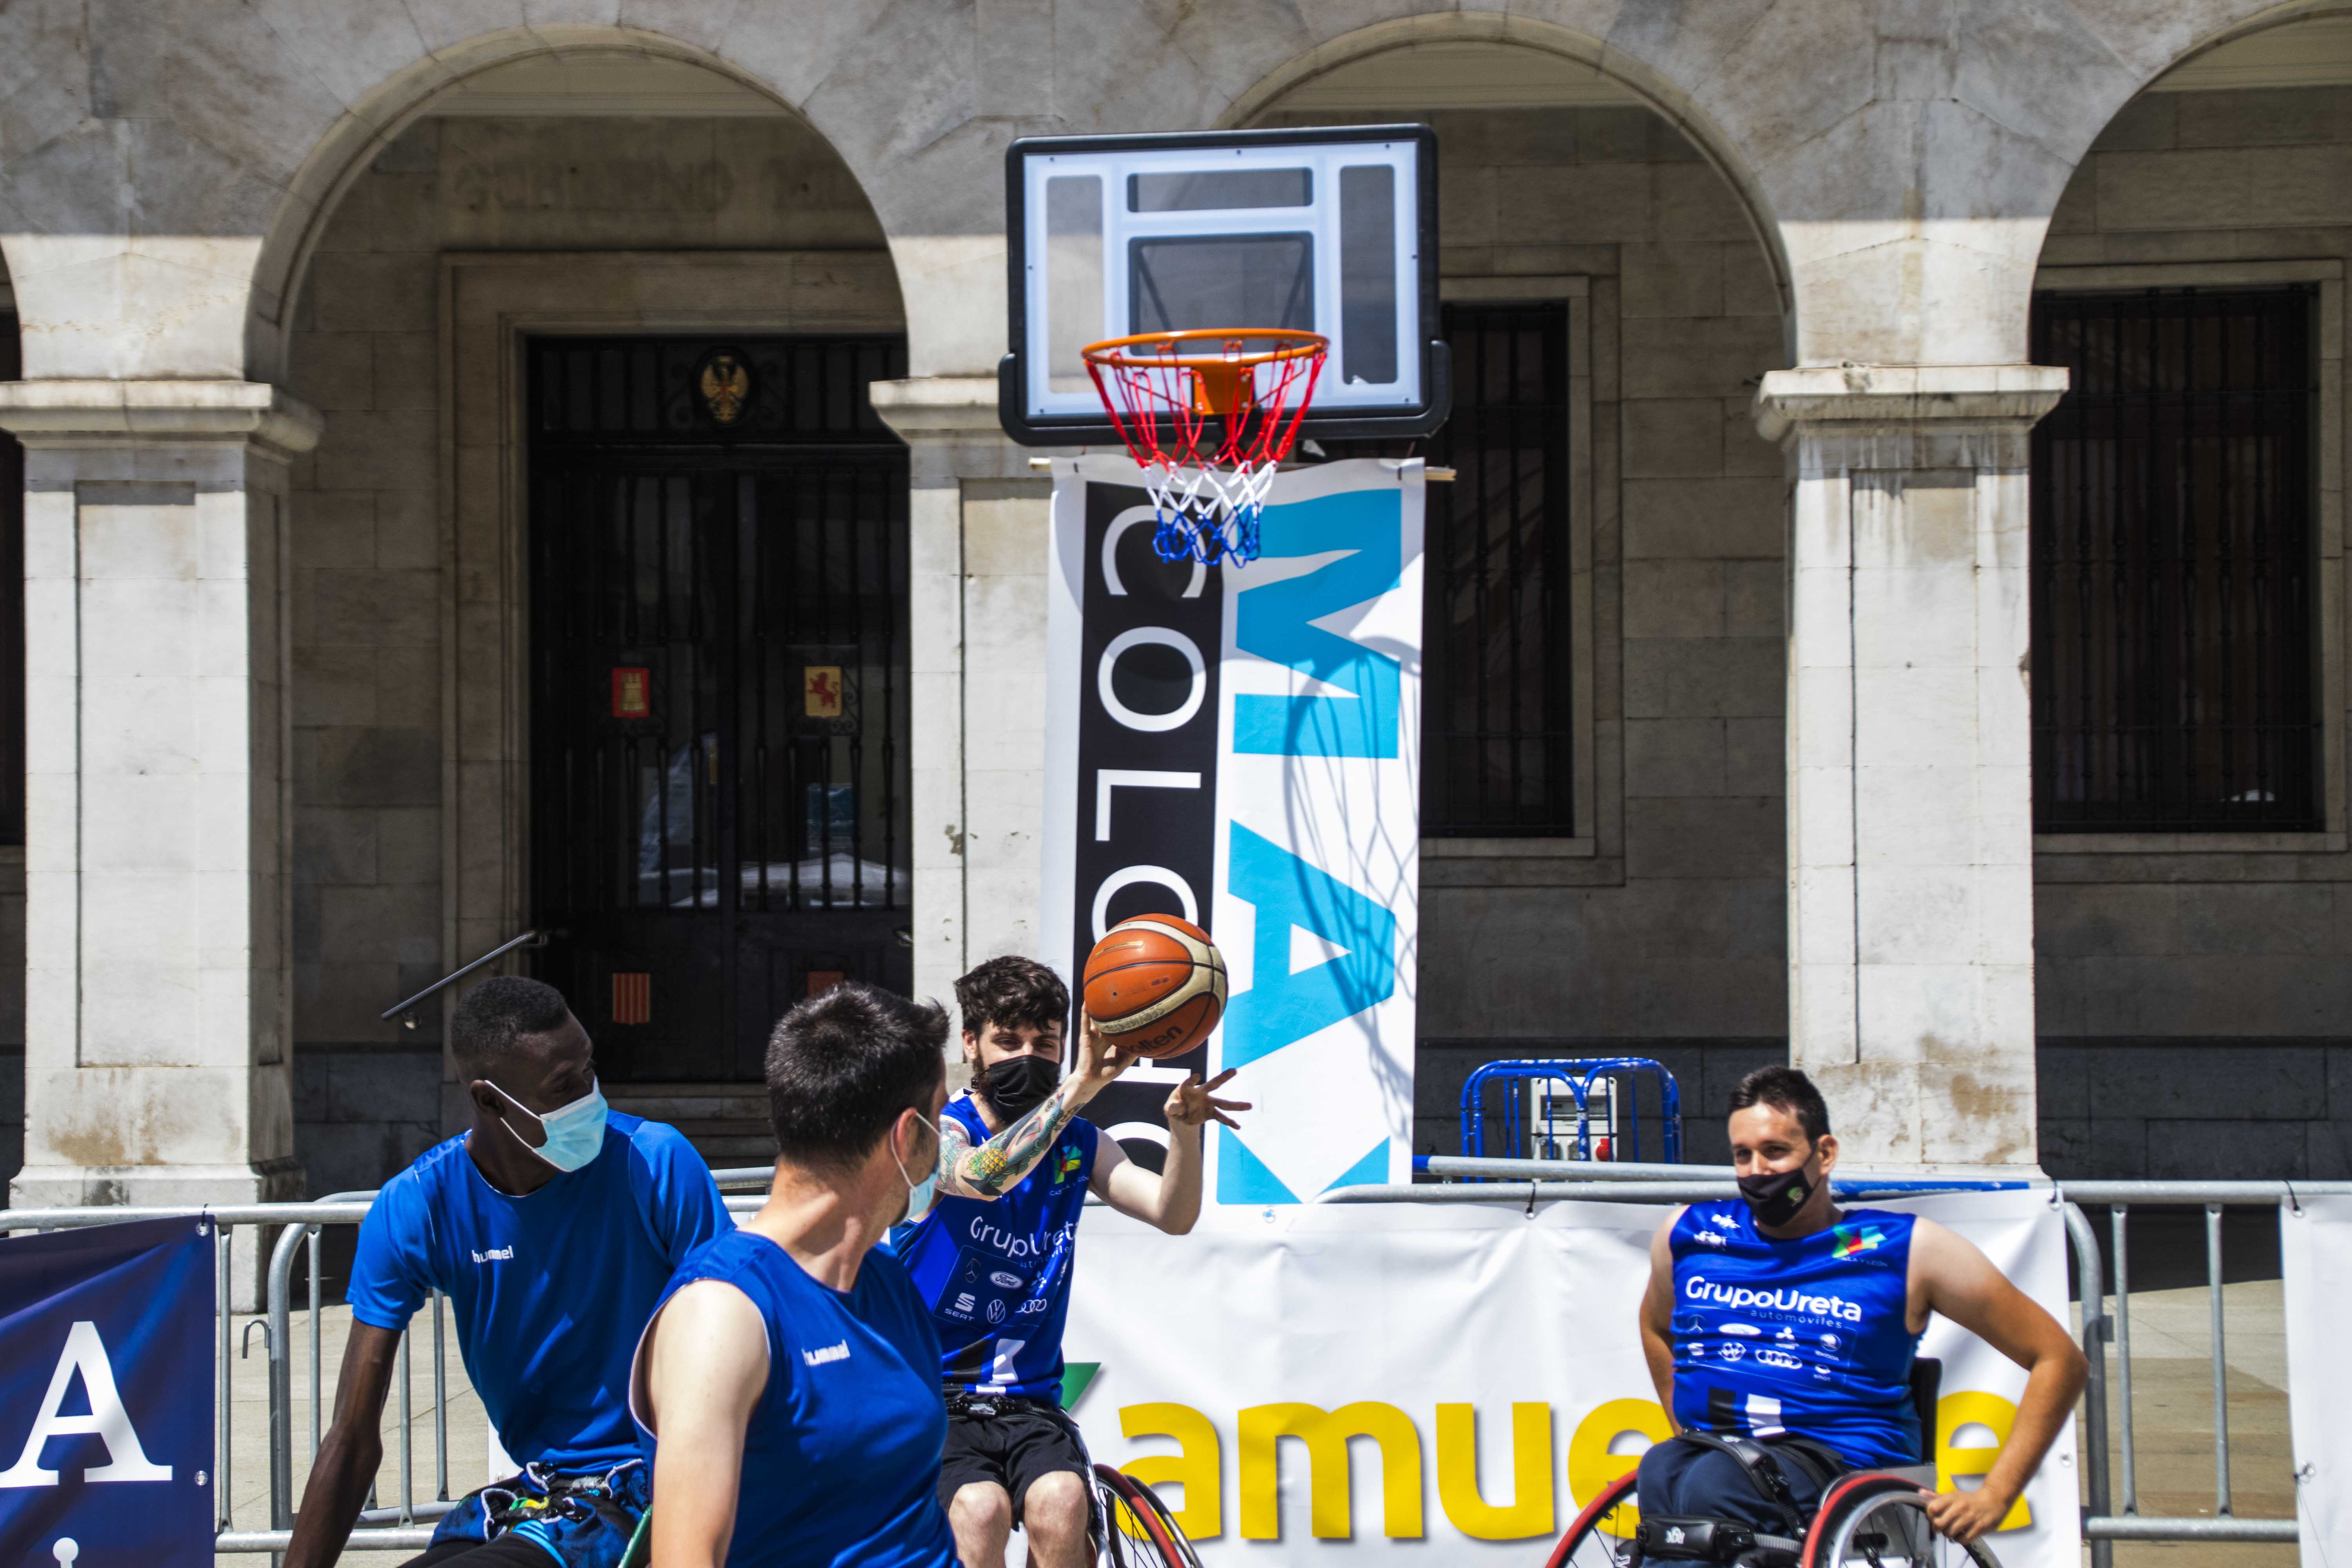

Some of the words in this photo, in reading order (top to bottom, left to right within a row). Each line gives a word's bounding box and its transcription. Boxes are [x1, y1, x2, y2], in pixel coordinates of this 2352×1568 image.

[471, 1245, 514, 1263] hummel
[995, 1274, 1018, 1287] Ford
[1685, 1275, 1862, 1323] GrupoUreta
[944, 1308, 975, 1322] SEAT
[1750, 1309, 1843, 1329] automoviles
[801, 1338, 851, 1367] hummel
